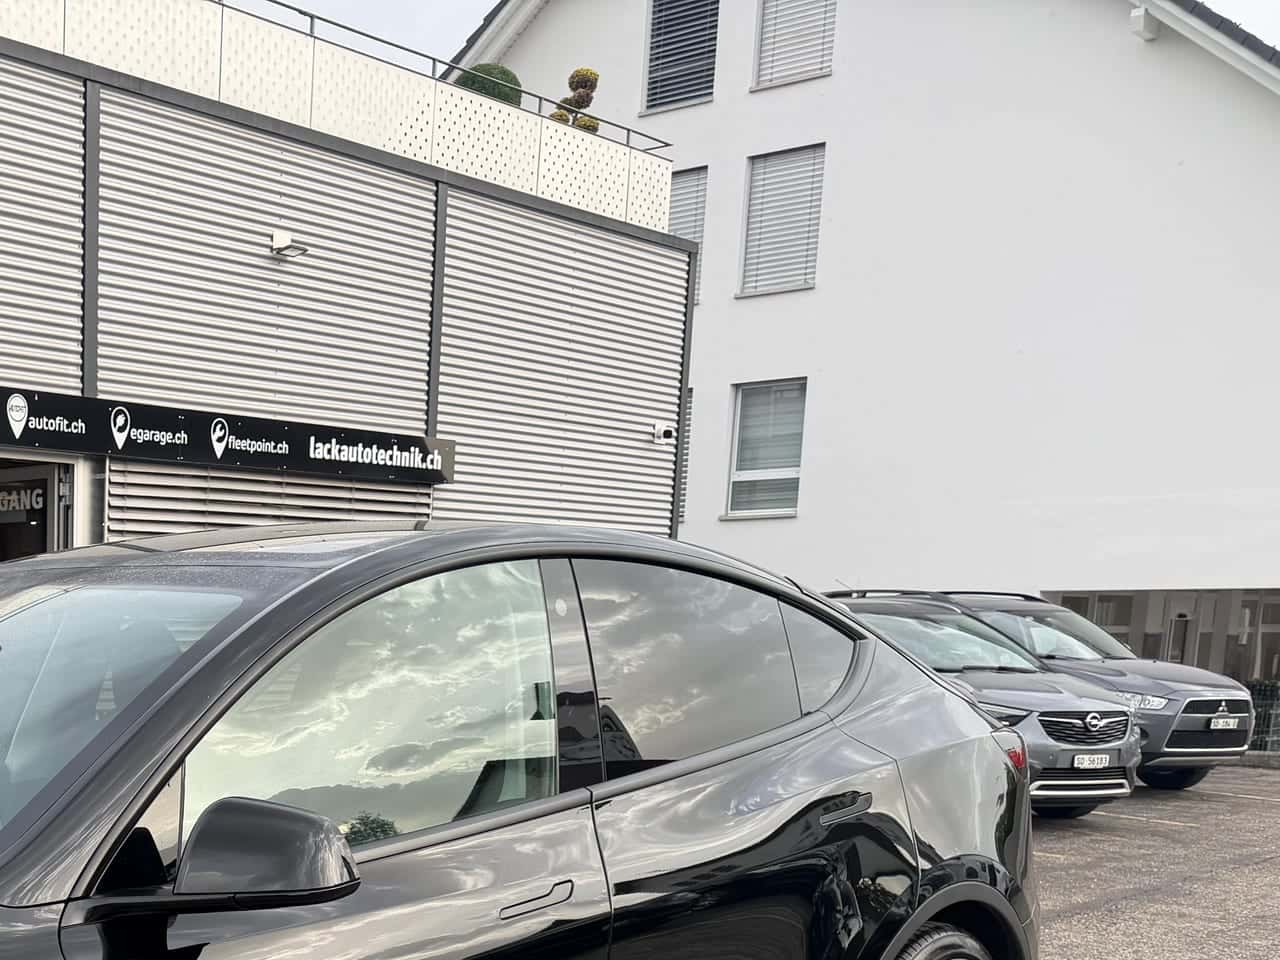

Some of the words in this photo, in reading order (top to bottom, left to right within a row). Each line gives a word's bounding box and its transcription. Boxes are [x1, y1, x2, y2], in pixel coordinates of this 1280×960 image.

[27, 414, 86, 435] autofit.ch
[129, 428, 189, 448] egarage.ch
[228, 435, 290, 455] fleetpoint.ch
[308, 435, 442, 471] lackautotechnik.ch
